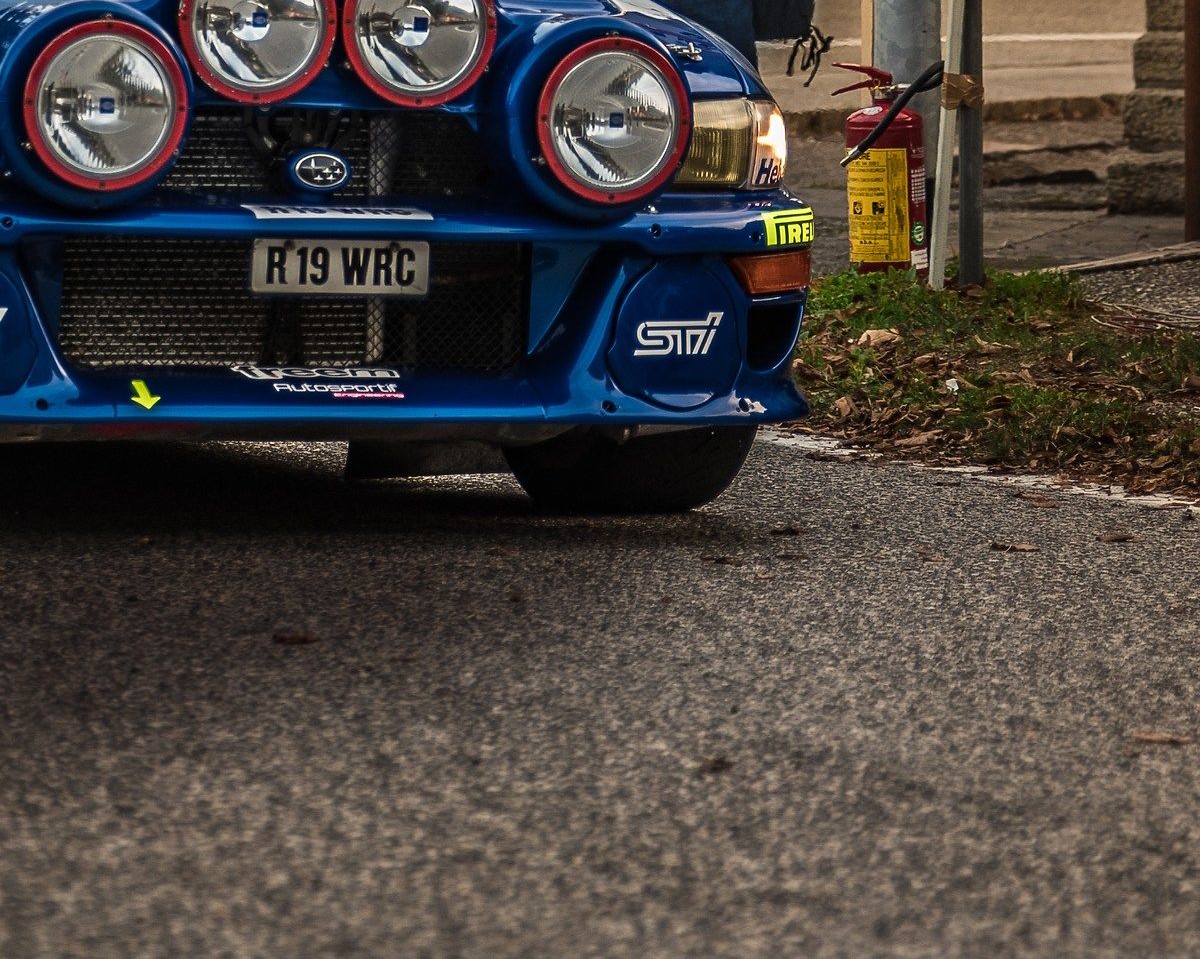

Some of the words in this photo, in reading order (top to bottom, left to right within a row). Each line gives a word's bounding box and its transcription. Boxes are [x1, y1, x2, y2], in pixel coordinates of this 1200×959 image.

[266, 246, 287, 284] R
[297, 246, 330, 286] 19
[341, 247, 416, 286] WRC
